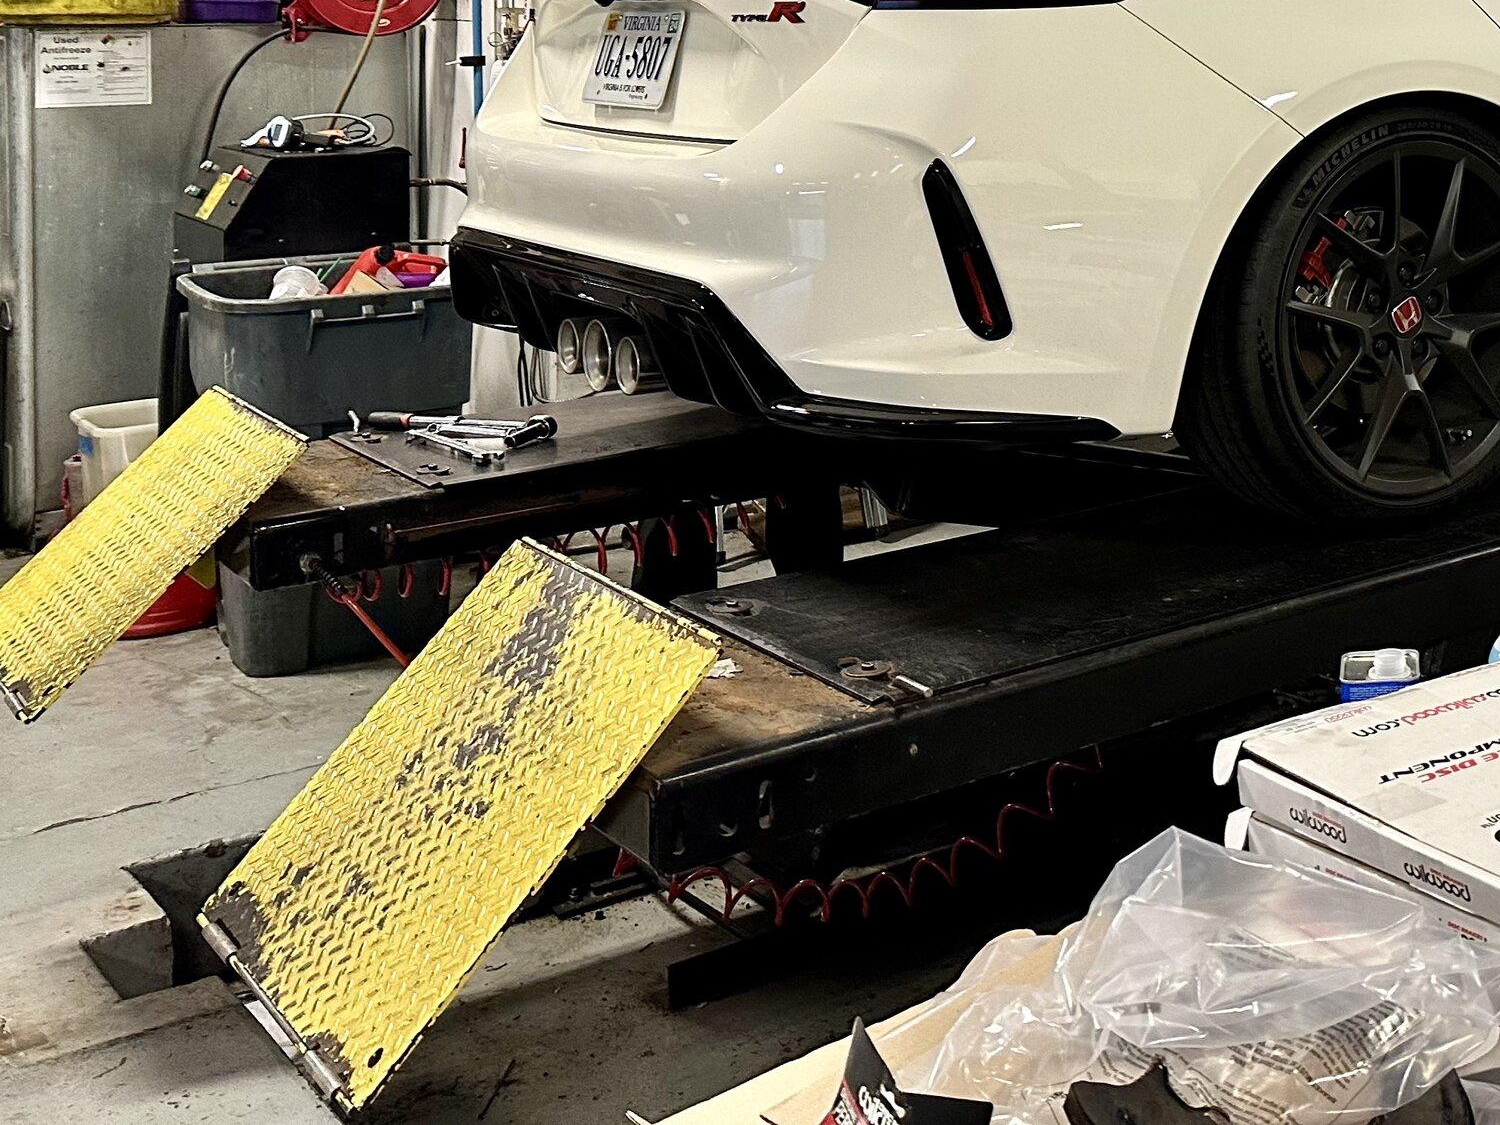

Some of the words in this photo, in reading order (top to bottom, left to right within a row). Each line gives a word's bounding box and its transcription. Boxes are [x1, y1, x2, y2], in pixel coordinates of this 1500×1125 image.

[624, 16, 661, 31] VIRGINIA
[767, 1, 806, 23] R
[41, 46, 91, 54] Antifreeze
[1311, 124, 1390, 185] MICHELIN
[1419, 758, 1478, 783] DISC
[1404, 862, 1471, 902] wilwood
